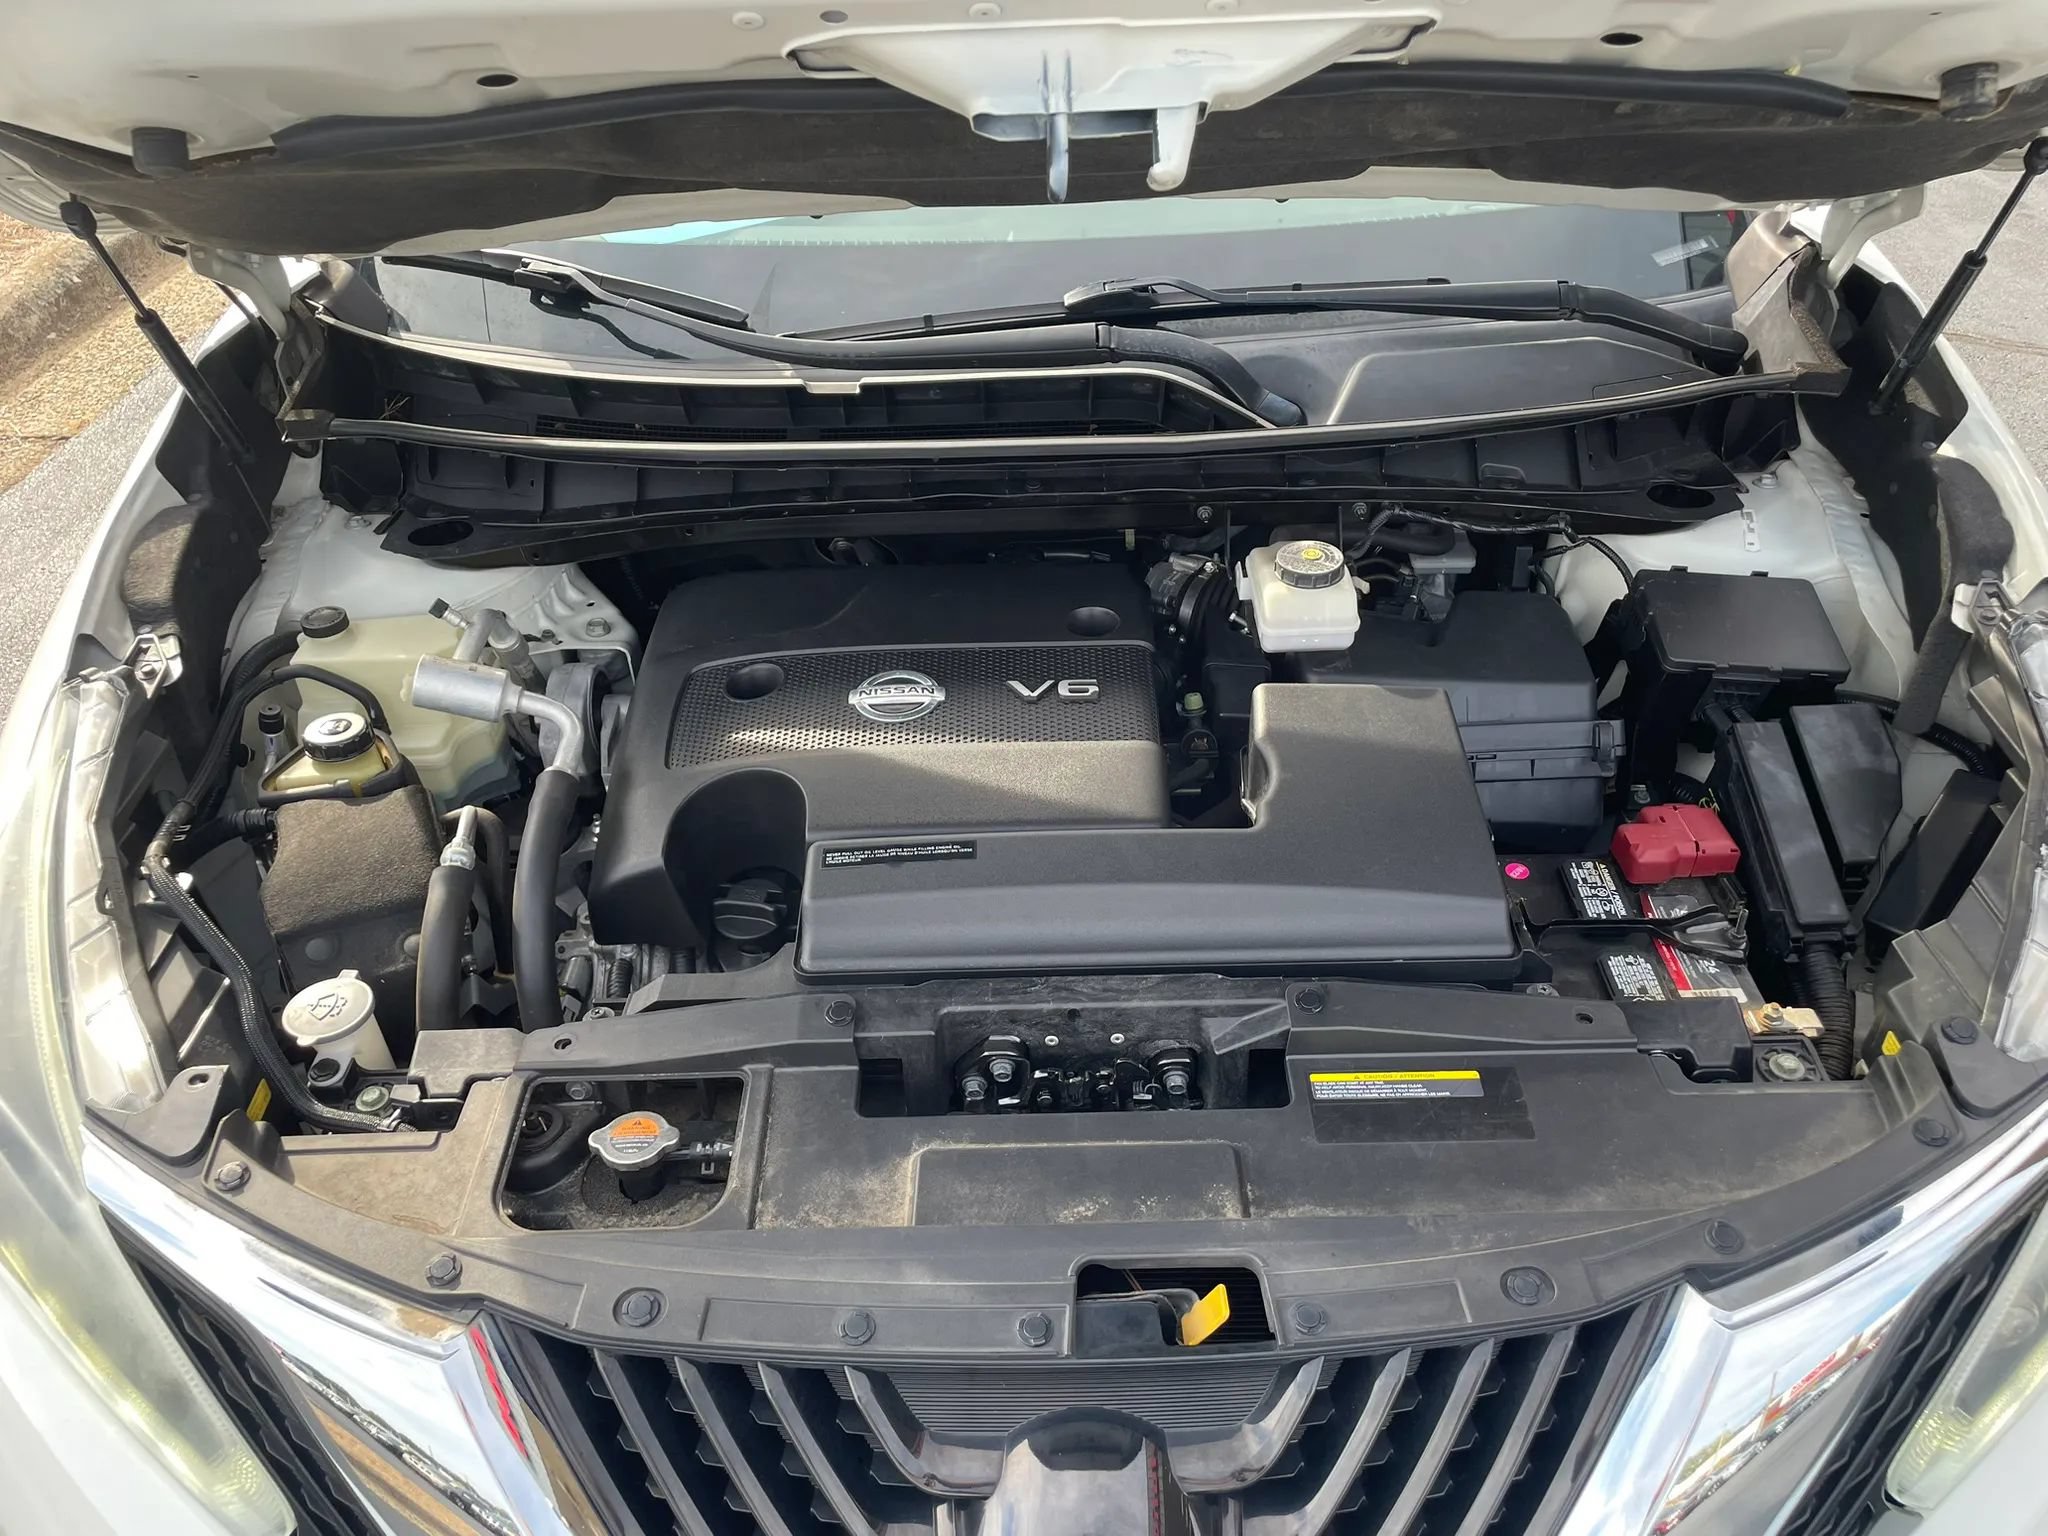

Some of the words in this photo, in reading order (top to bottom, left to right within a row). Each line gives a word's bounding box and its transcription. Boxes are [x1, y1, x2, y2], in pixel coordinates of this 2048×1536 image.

[858, 686, 935, 697] NISSAN
[1007, 679, 1100, 699] V6
[1602, 868, 1616, 890] DANGER
[1612, 894, 1627, 916] POISON
